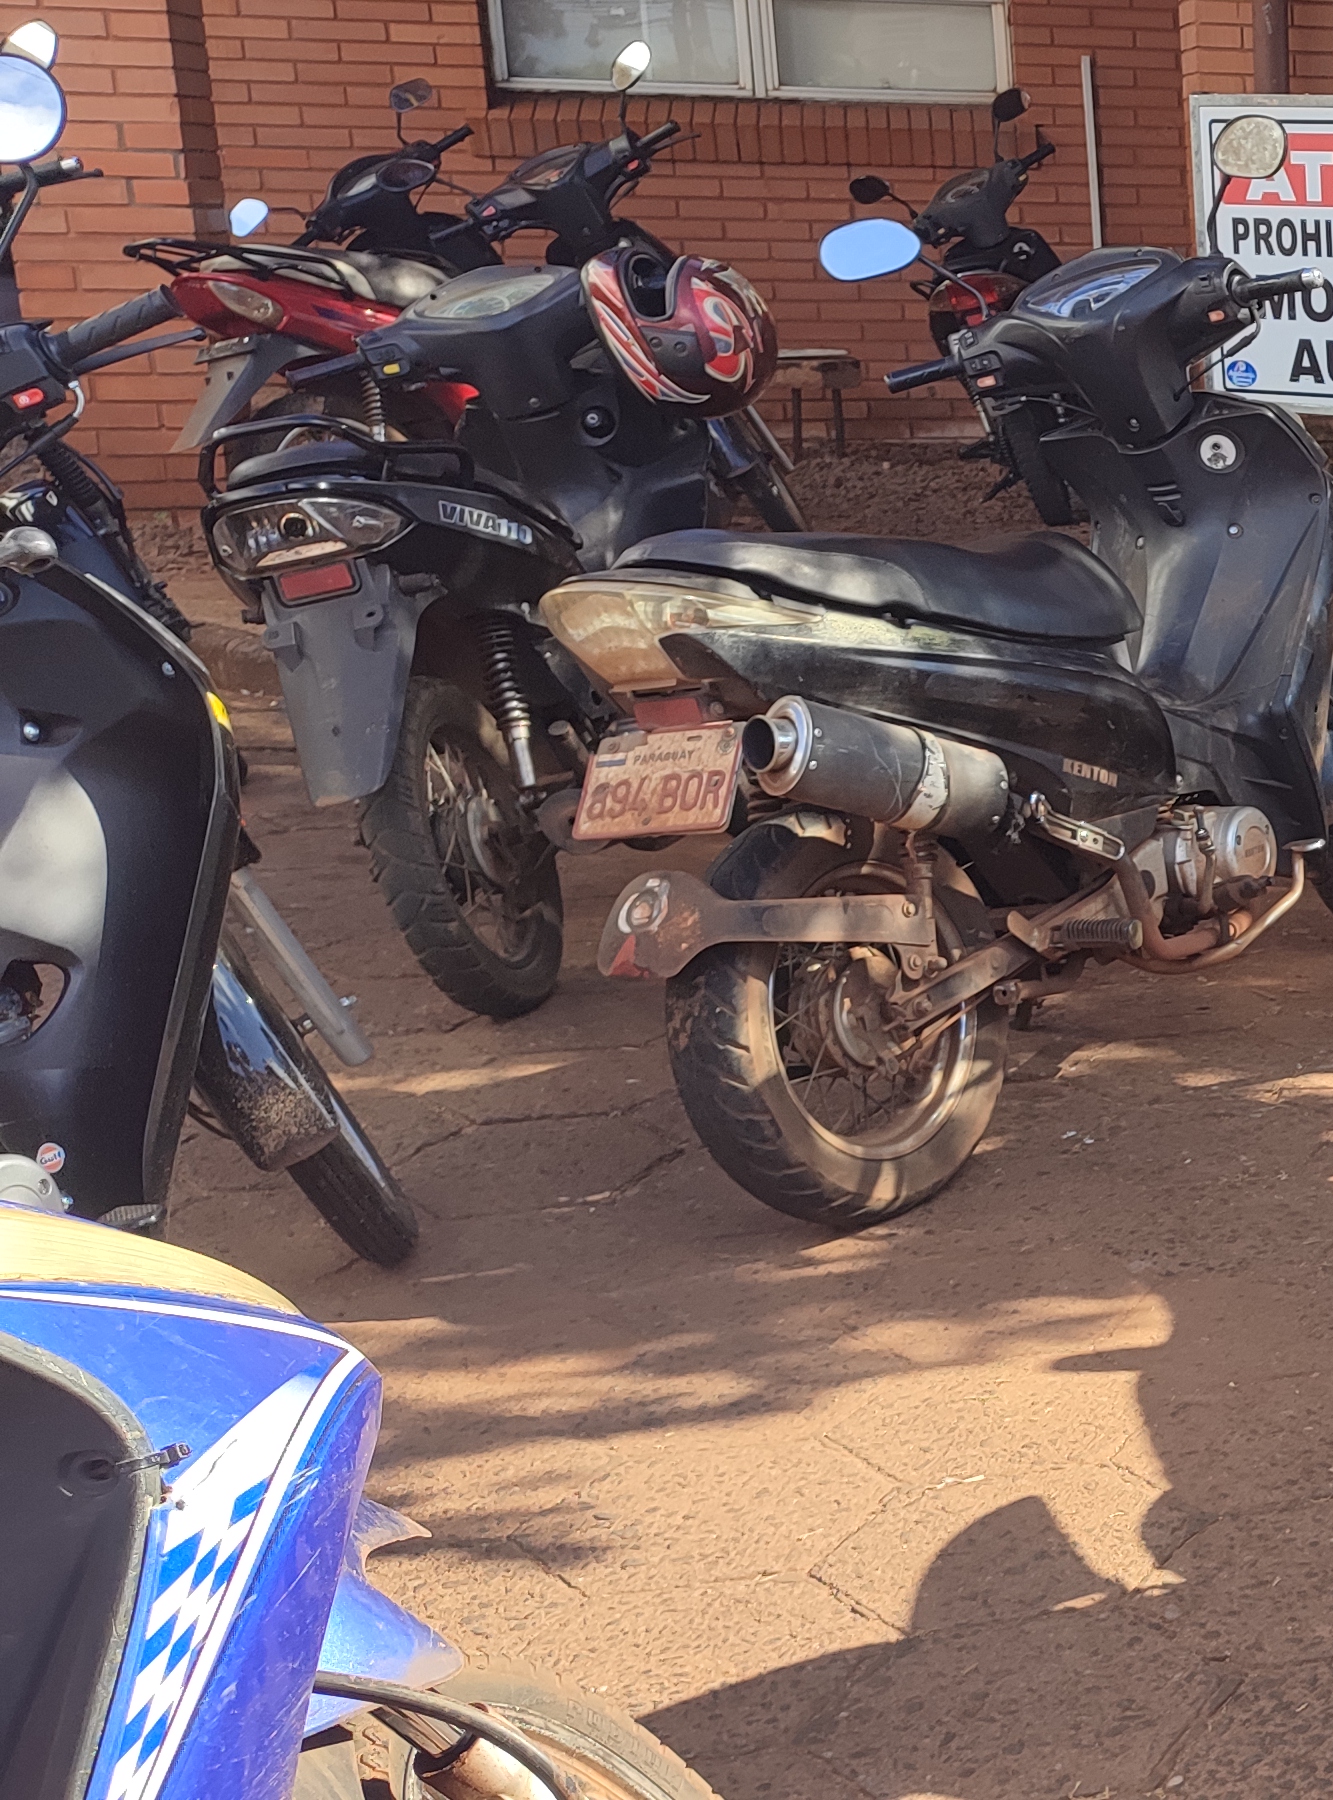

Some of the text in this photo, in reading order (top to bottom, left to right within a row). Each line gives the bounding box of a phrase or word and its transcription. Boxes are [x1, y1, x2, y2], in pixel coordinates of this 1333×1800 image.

[633, 749, 695, 765] PARAGUAY
[1062, 757, 1118, 788] KENTON
[656, 769, 726, 815] BOR
